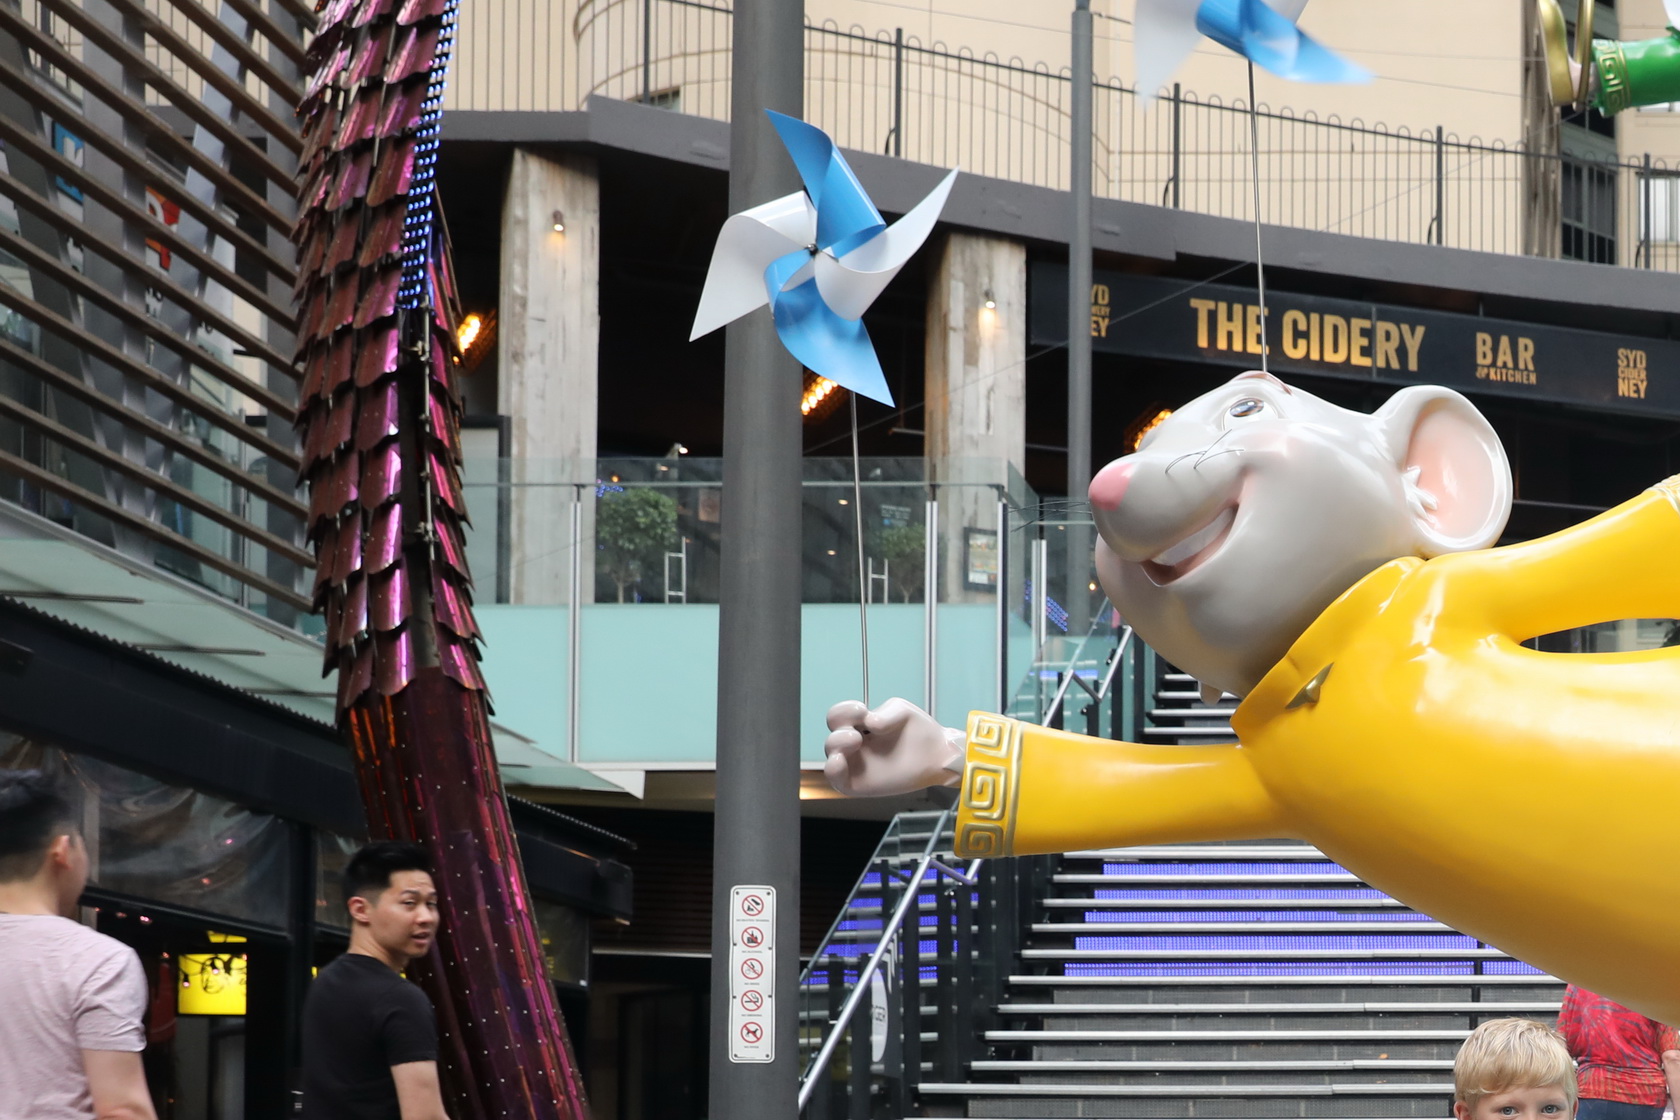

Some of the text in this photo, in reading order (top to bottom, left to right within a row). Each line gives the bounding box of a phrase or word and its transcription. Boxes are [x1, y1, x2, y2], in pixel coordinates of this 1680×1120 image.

[1190, 298, 1426, 372] THE CIDERY
[1476, 332, 1535, 371] BAR
[1617, 348, 1647, 369] SYD
[1618, 378, 1648, 399] NEY
